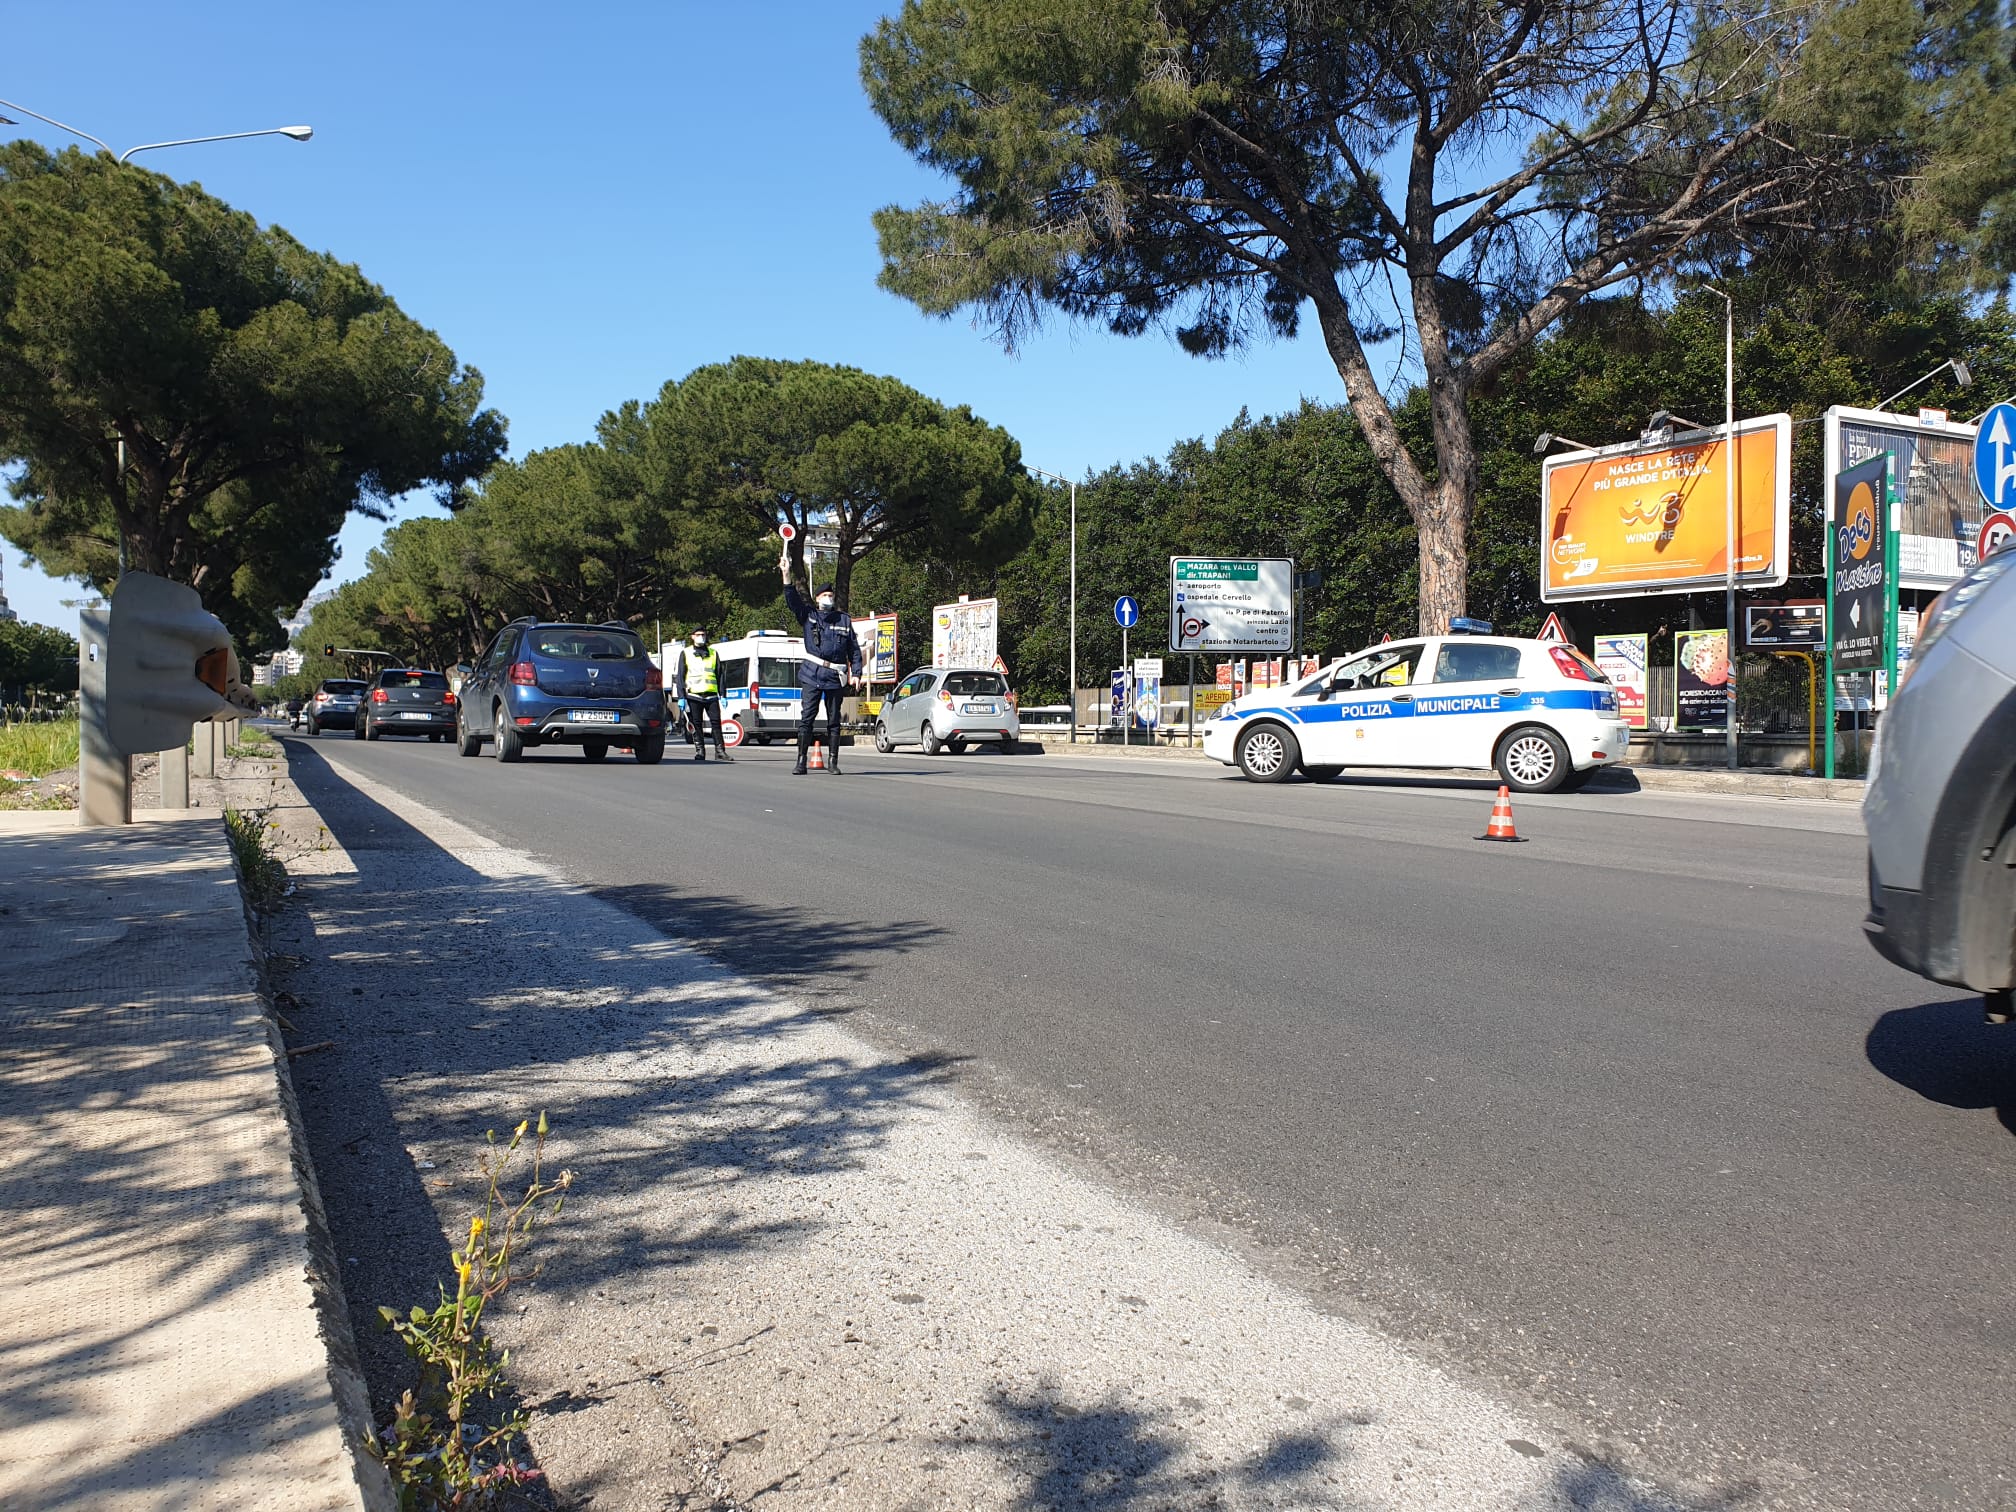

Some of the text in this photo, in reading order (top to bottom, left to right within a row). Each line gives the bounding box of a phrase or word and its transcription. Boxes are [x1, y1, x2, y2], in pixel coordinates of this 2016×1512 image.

[1608, 452, 1695, 476] NASCE LA RETE
[1593, 478, 1611, 491] PIÙ
[1614, 472, 1659, 488] GRANDE
[1625, 530, 1675, 544] WINDTRE
[1850, 638, 1856, 649] LO
[1873, 635, 1879, 646] 11
[1205, 692, 1230, 701] APERTO
[1531, 697, 1545, 705] 335
[1341, 697, 1500, 718] POLIZIA MUNICIPALE
